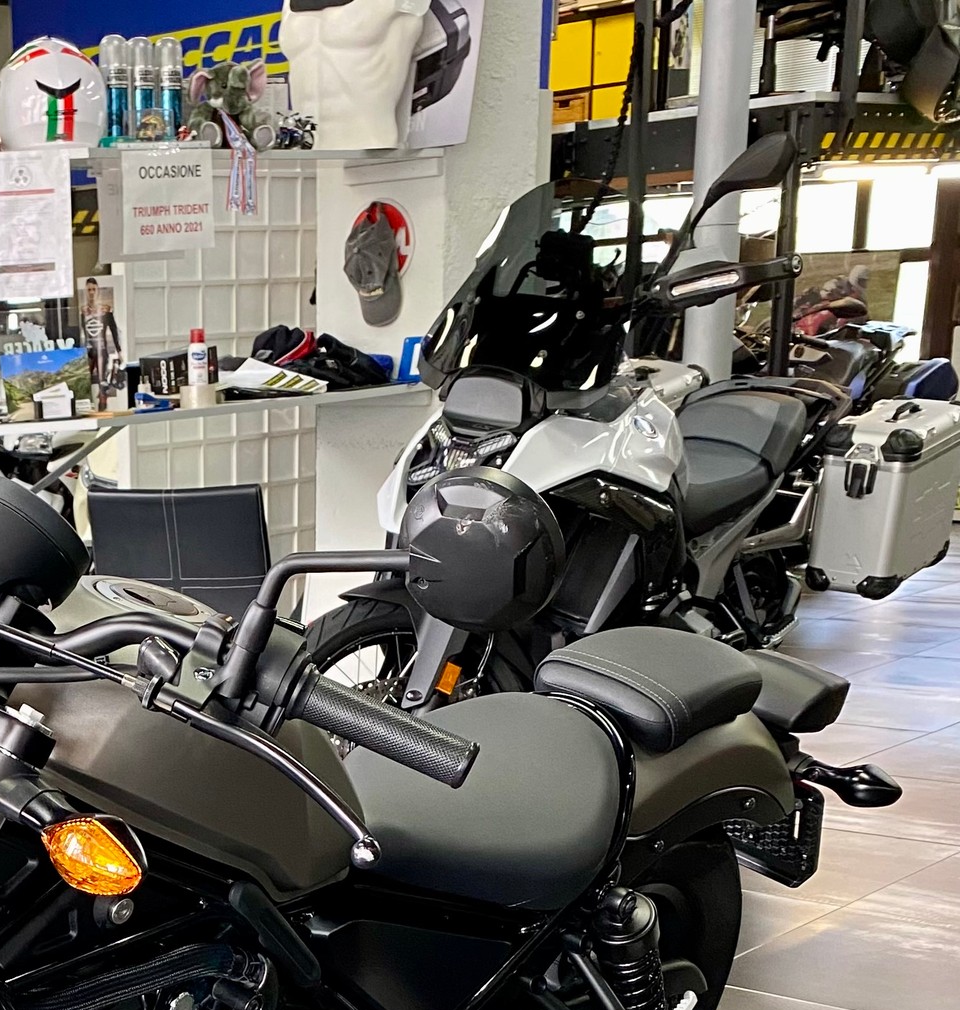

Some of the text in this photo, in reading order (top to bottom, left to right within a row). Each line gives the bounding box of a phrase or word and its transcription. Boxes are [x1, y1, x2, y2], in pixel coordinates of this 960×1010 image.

[138, 164, 202, 180] OCCASIONE
[133, 203, 209, 218] TRIUMPH TRIDENT
[140, 221, 203, 236] 660 ANNO 2021
[160, 360, 169, 394] NOCO
